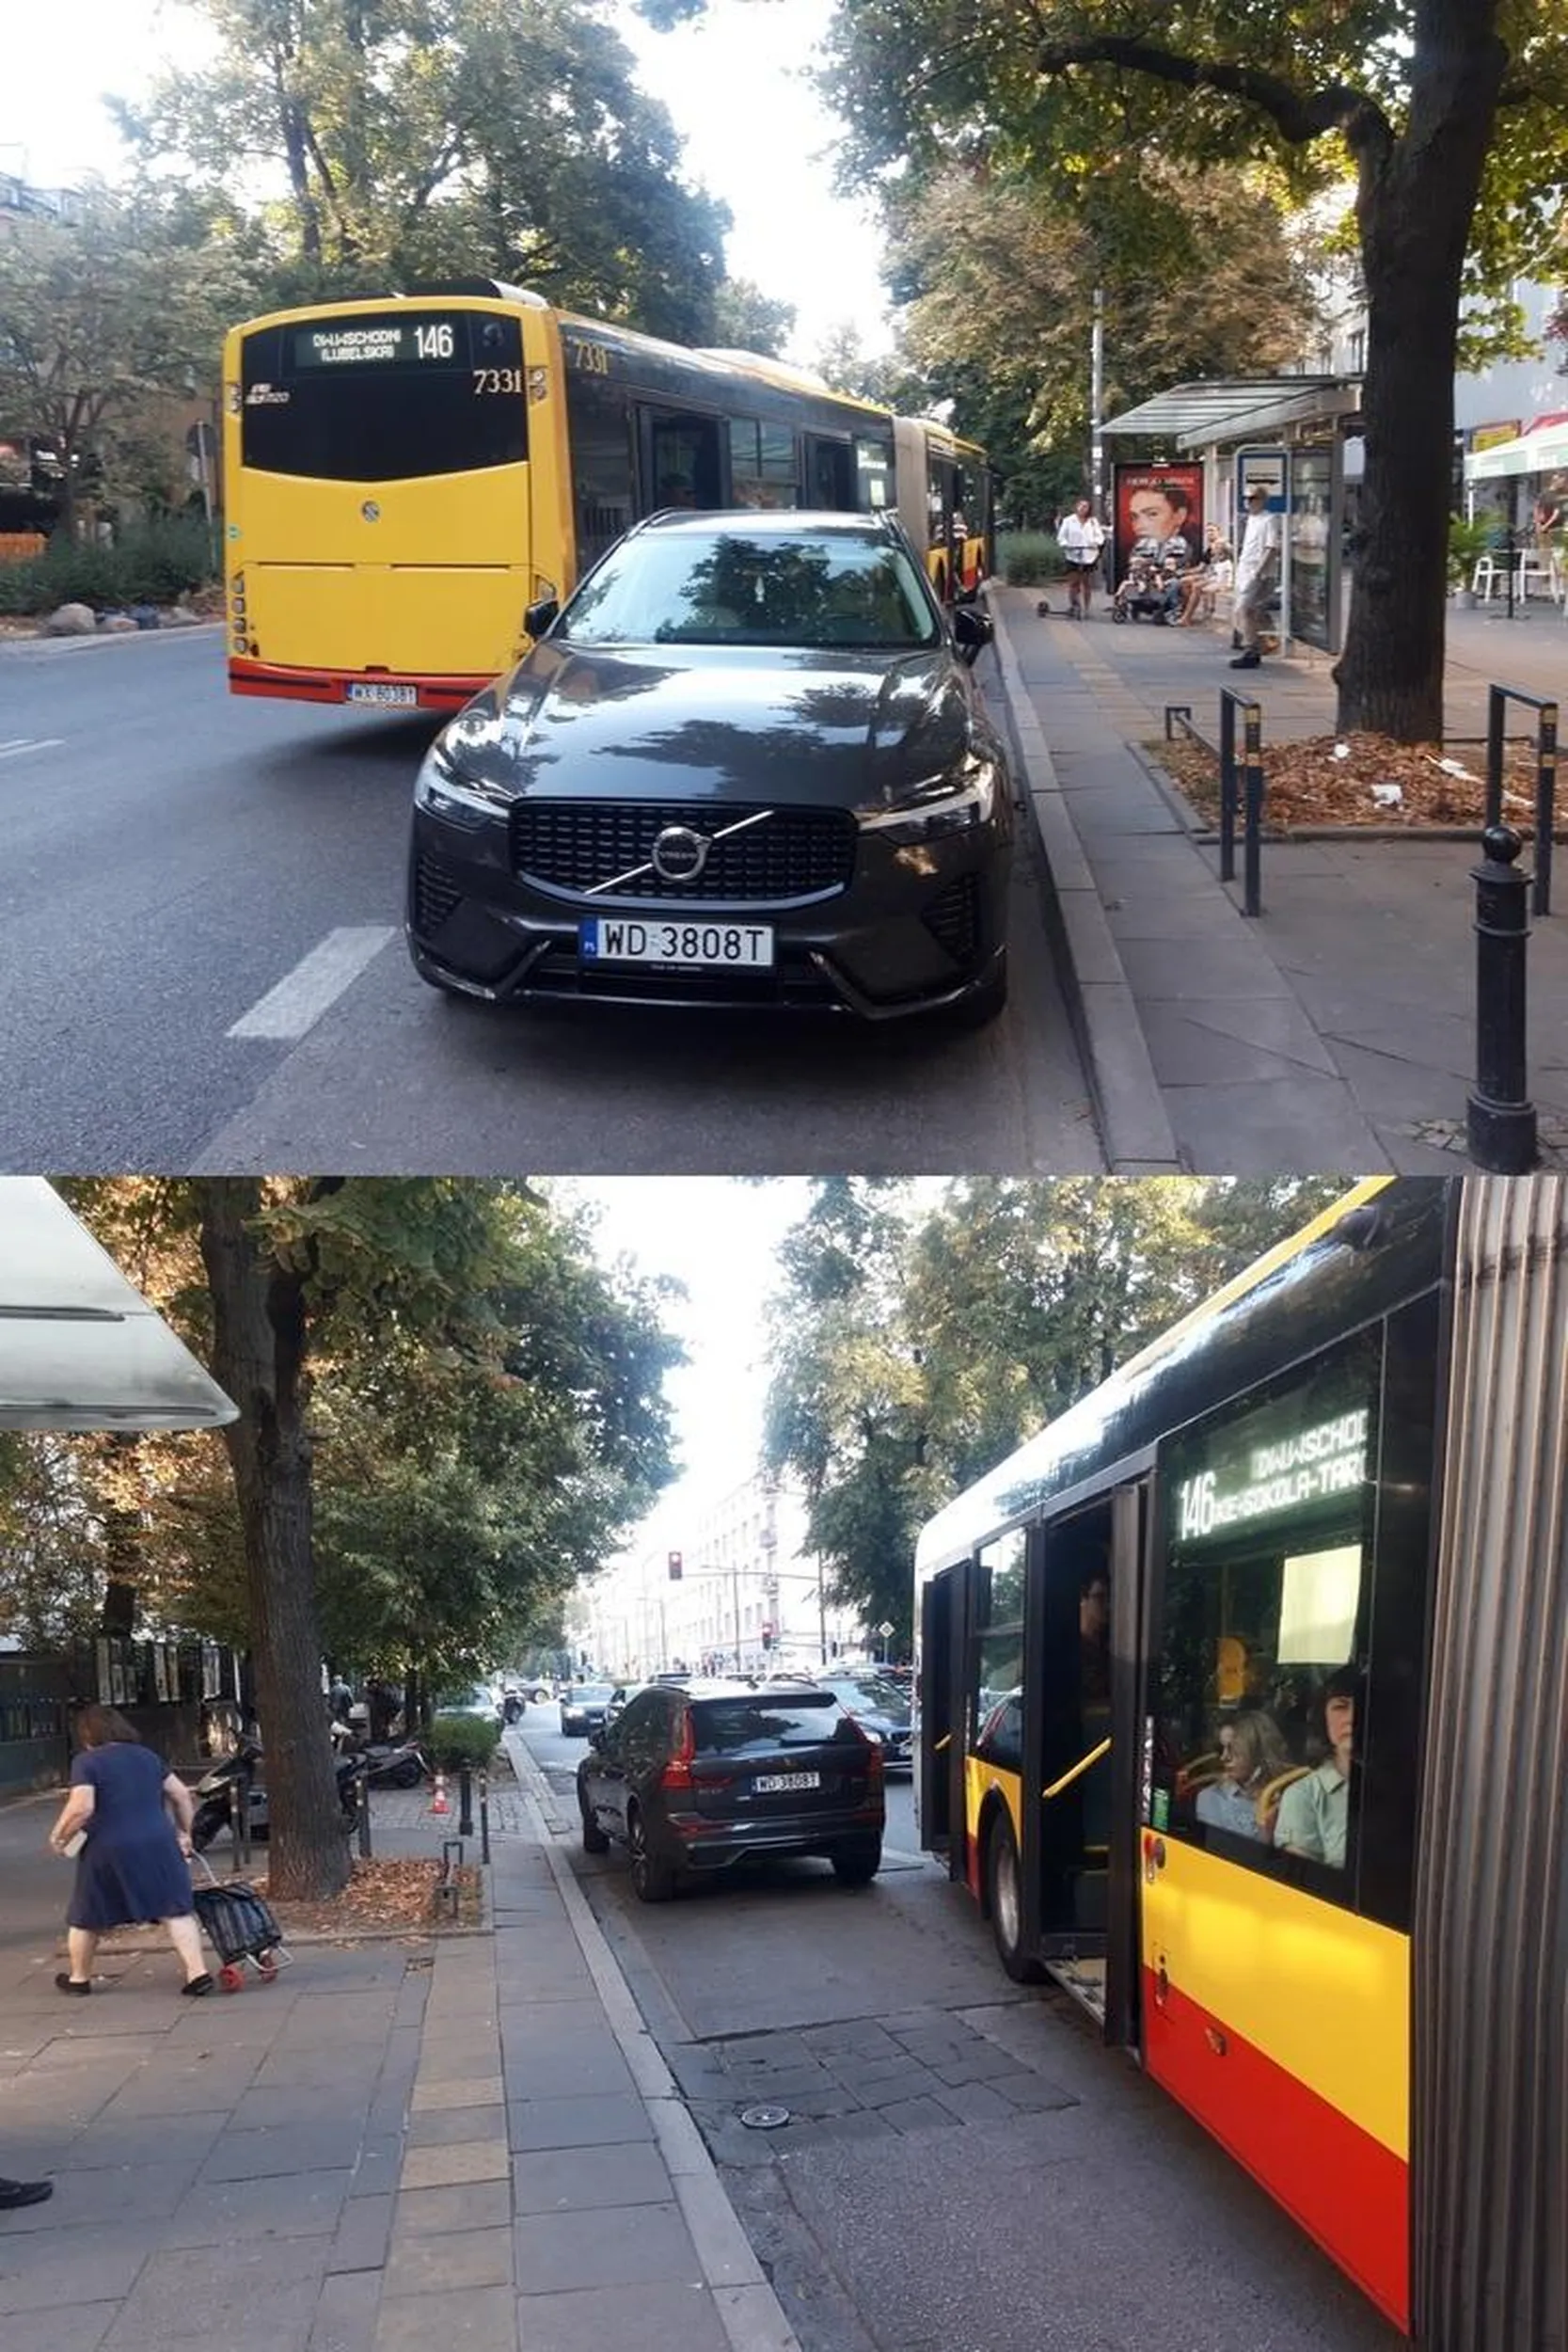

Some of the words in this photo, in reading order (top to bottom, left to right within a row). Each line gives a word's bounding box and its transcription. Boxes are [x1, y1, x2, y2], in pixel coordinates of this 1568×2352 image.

[414, 325, 453, 358] 146
[576, 342, 609, 374] 7331
[473, 368, 523, 394] 7331
[605, 923, 646, 956] WD
[661, 926, 764, 961] 3808T
[1180, 1470, 1216, 1541] 146
